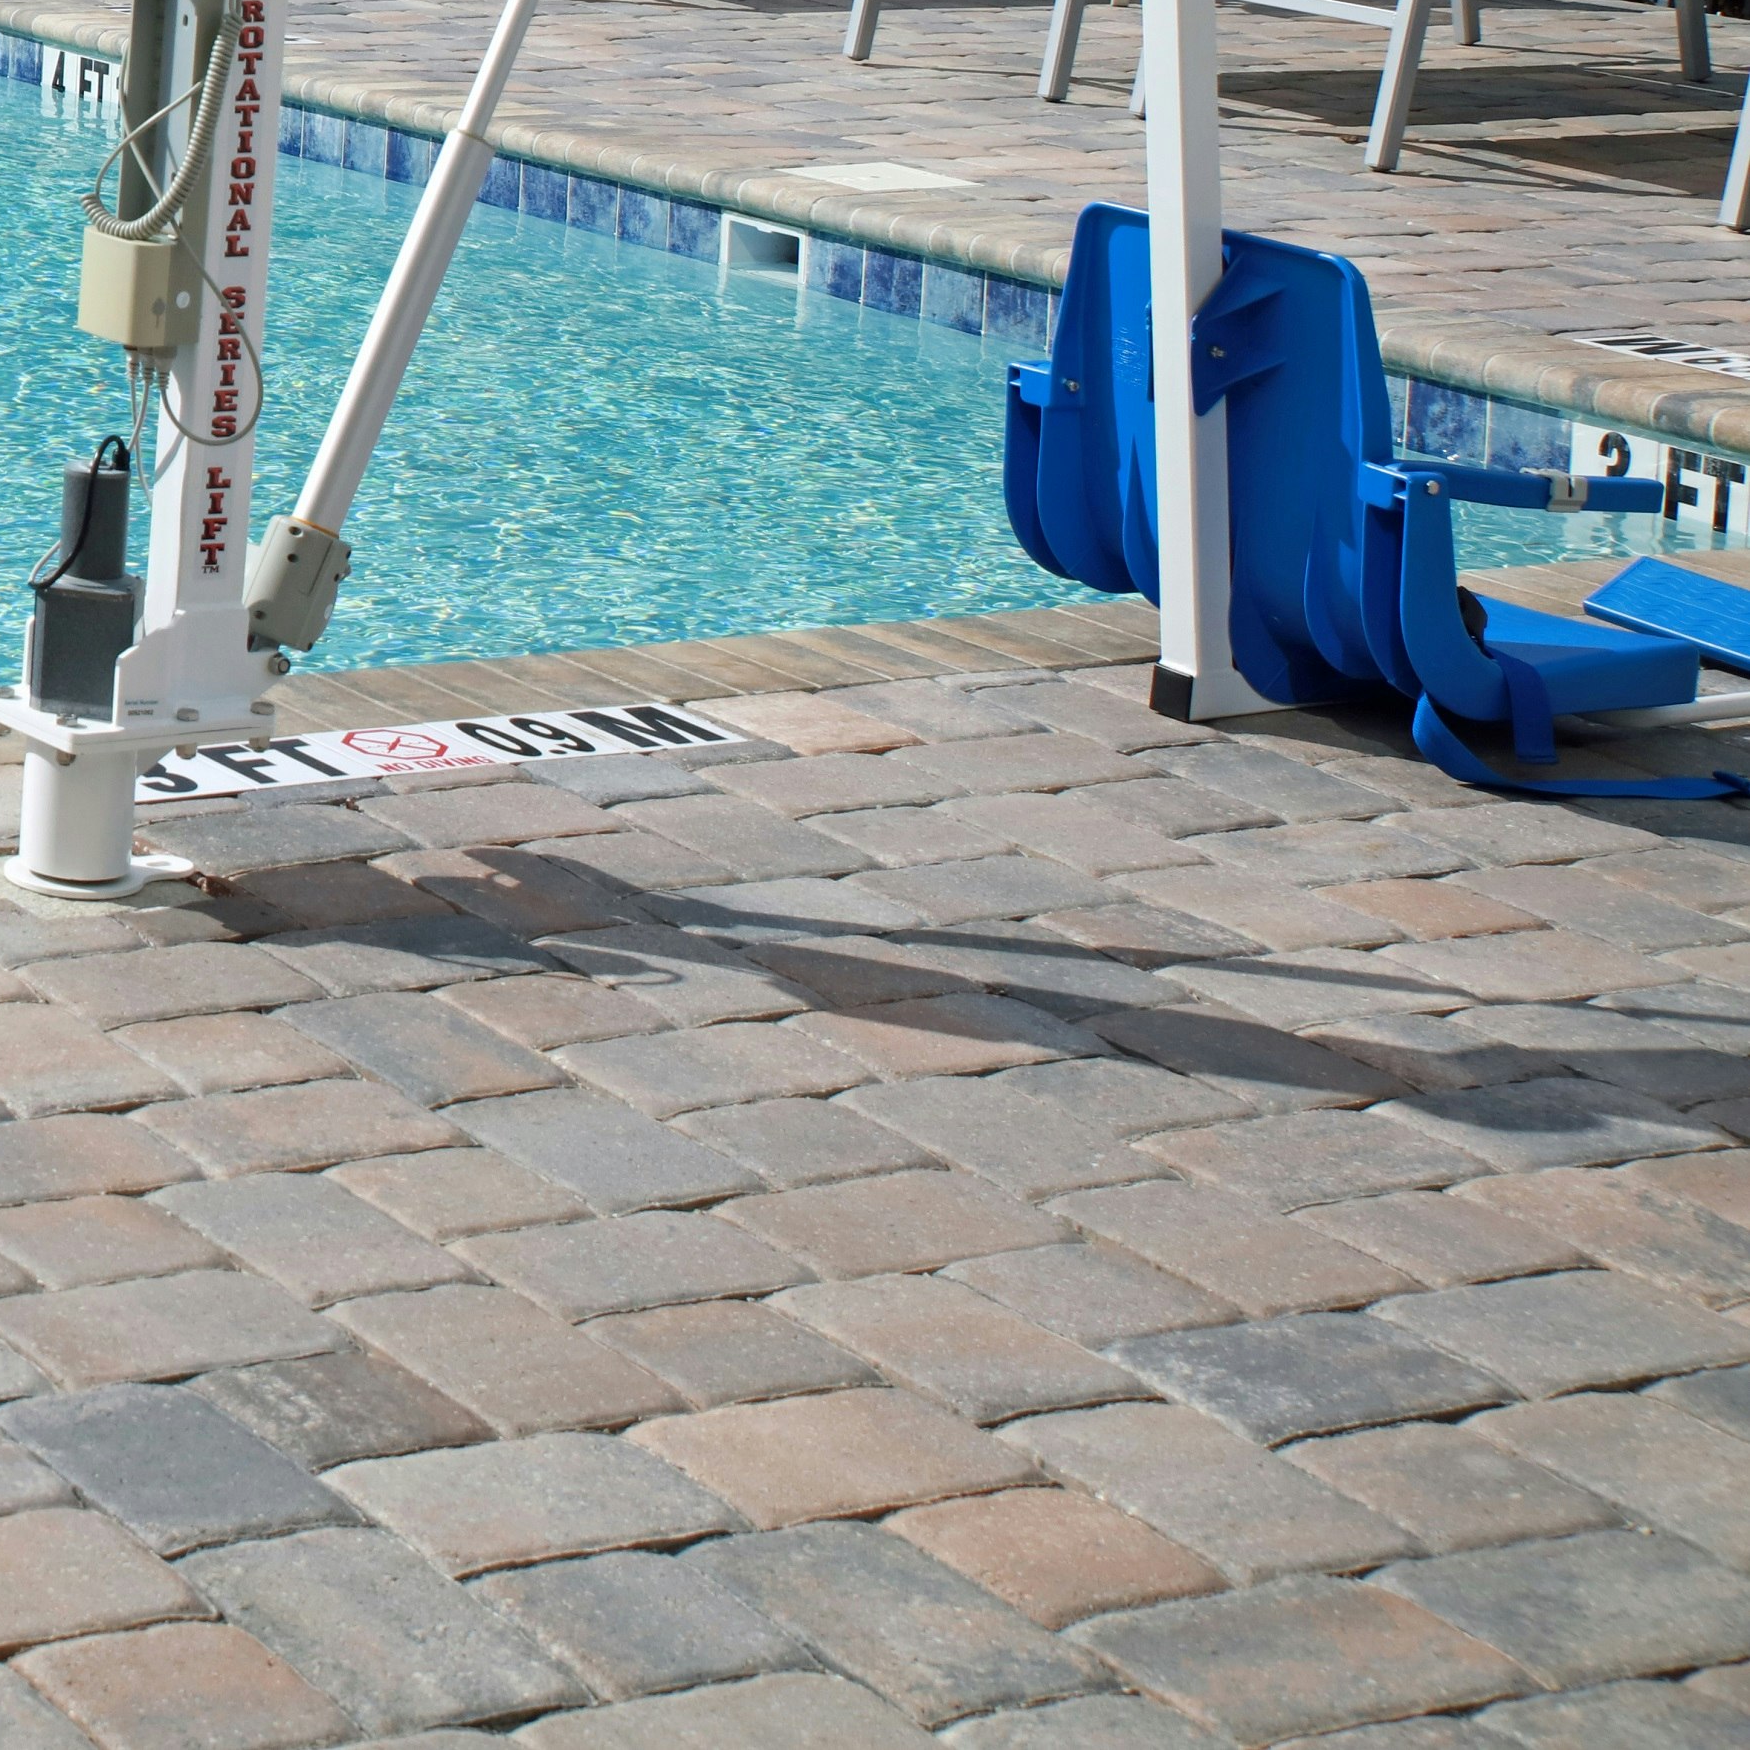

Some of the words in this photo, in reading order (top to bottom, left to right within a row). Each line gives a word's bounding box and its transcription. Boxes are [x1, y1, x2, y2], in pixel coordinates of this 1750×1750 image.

[52, 51, 65, 93] 4
[79, 57, 109, 103] FT
[224, 0, 265, 257] ROTATIONAL
[211, 286, 246, 437] SERIES
[200, 467, 231, 565] LIFT
[1664, 447, 1746, 534] FT
[197, 738, 349, 784] FT
[455, 718, 596, 757] 0.9
[566, 706, 728, 747] M
[376, 760, 411, 773] NO
[413, 754, 495, 770] DIVING
